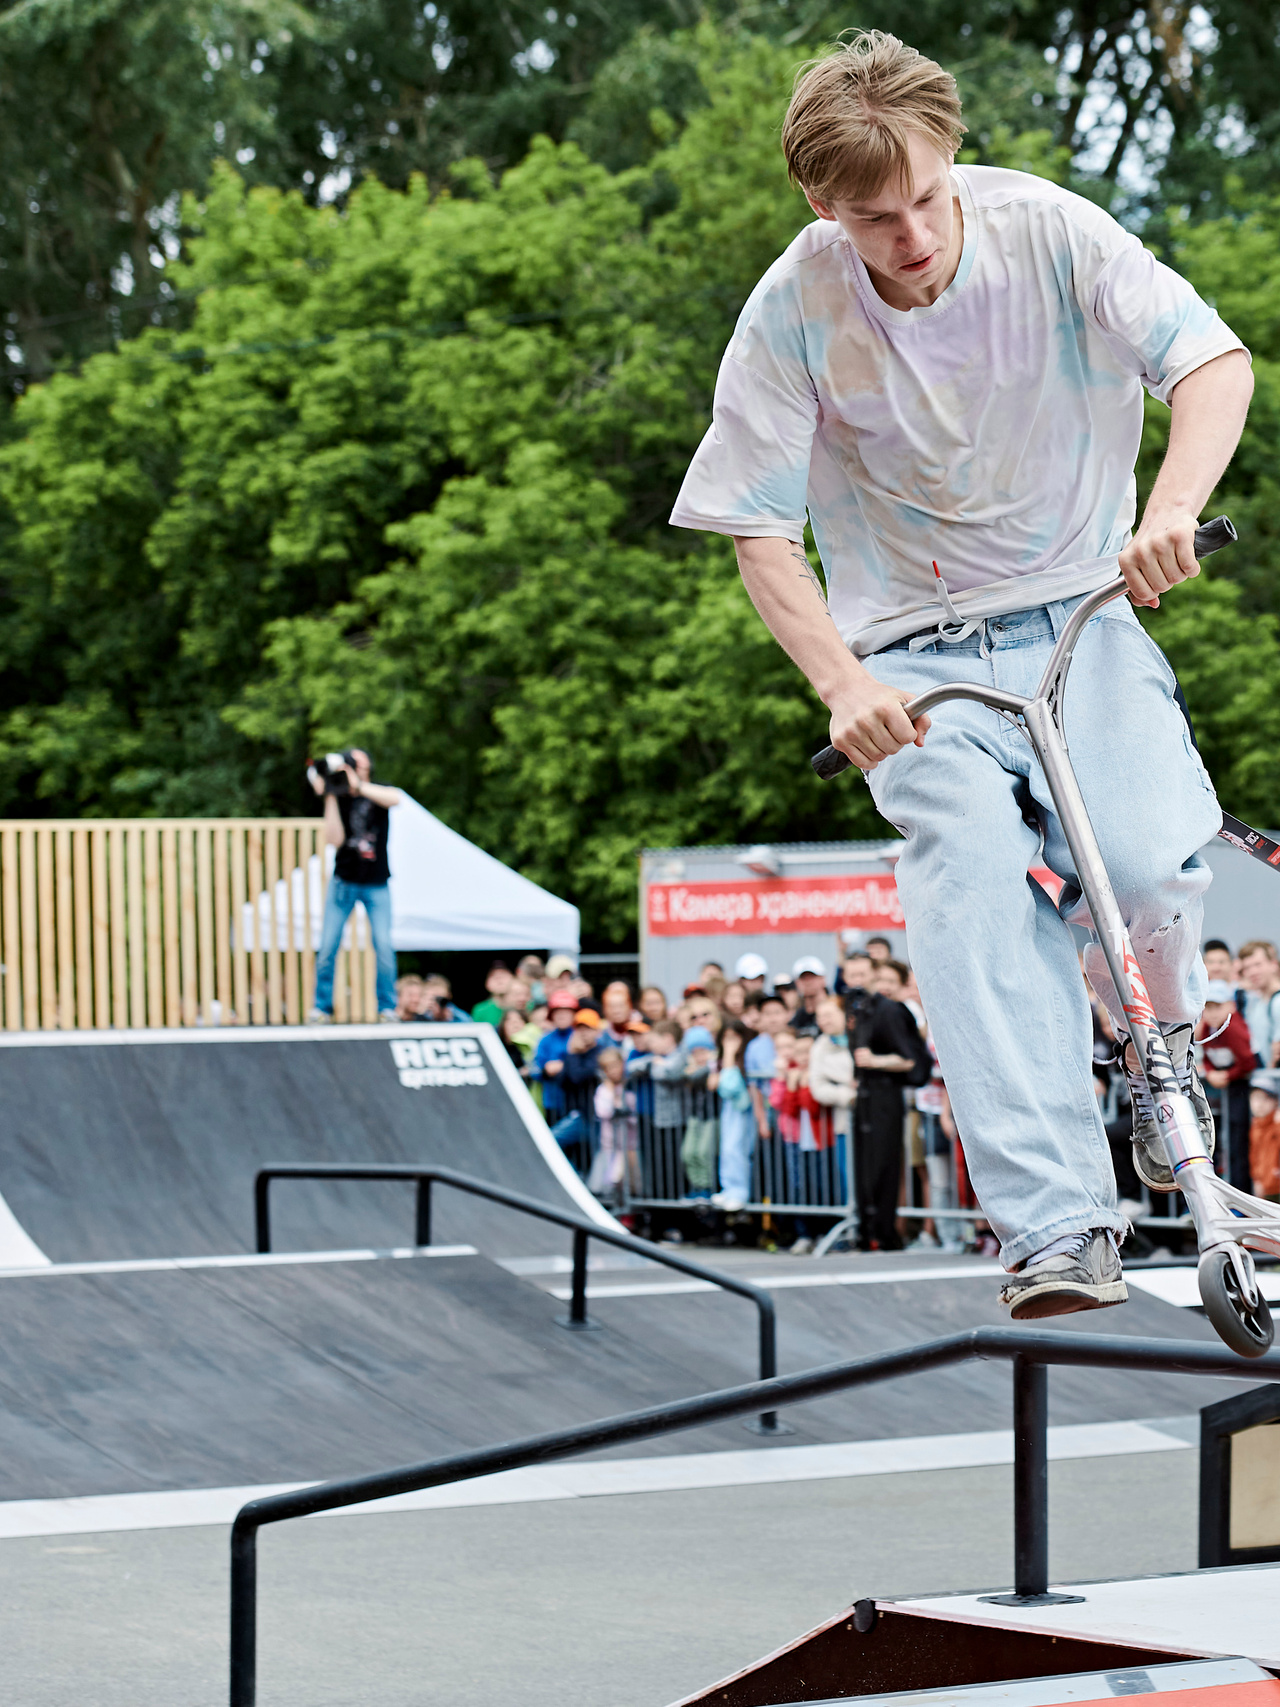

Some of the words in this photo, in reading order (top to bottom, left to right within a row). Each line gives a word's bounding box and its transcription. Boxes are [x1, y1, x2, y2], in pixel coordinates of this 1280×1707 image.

[668, 887, 754, 928] Камера
[756, 888, 867, 927] хранения
[390, 1039, 483, 1068] RCC
